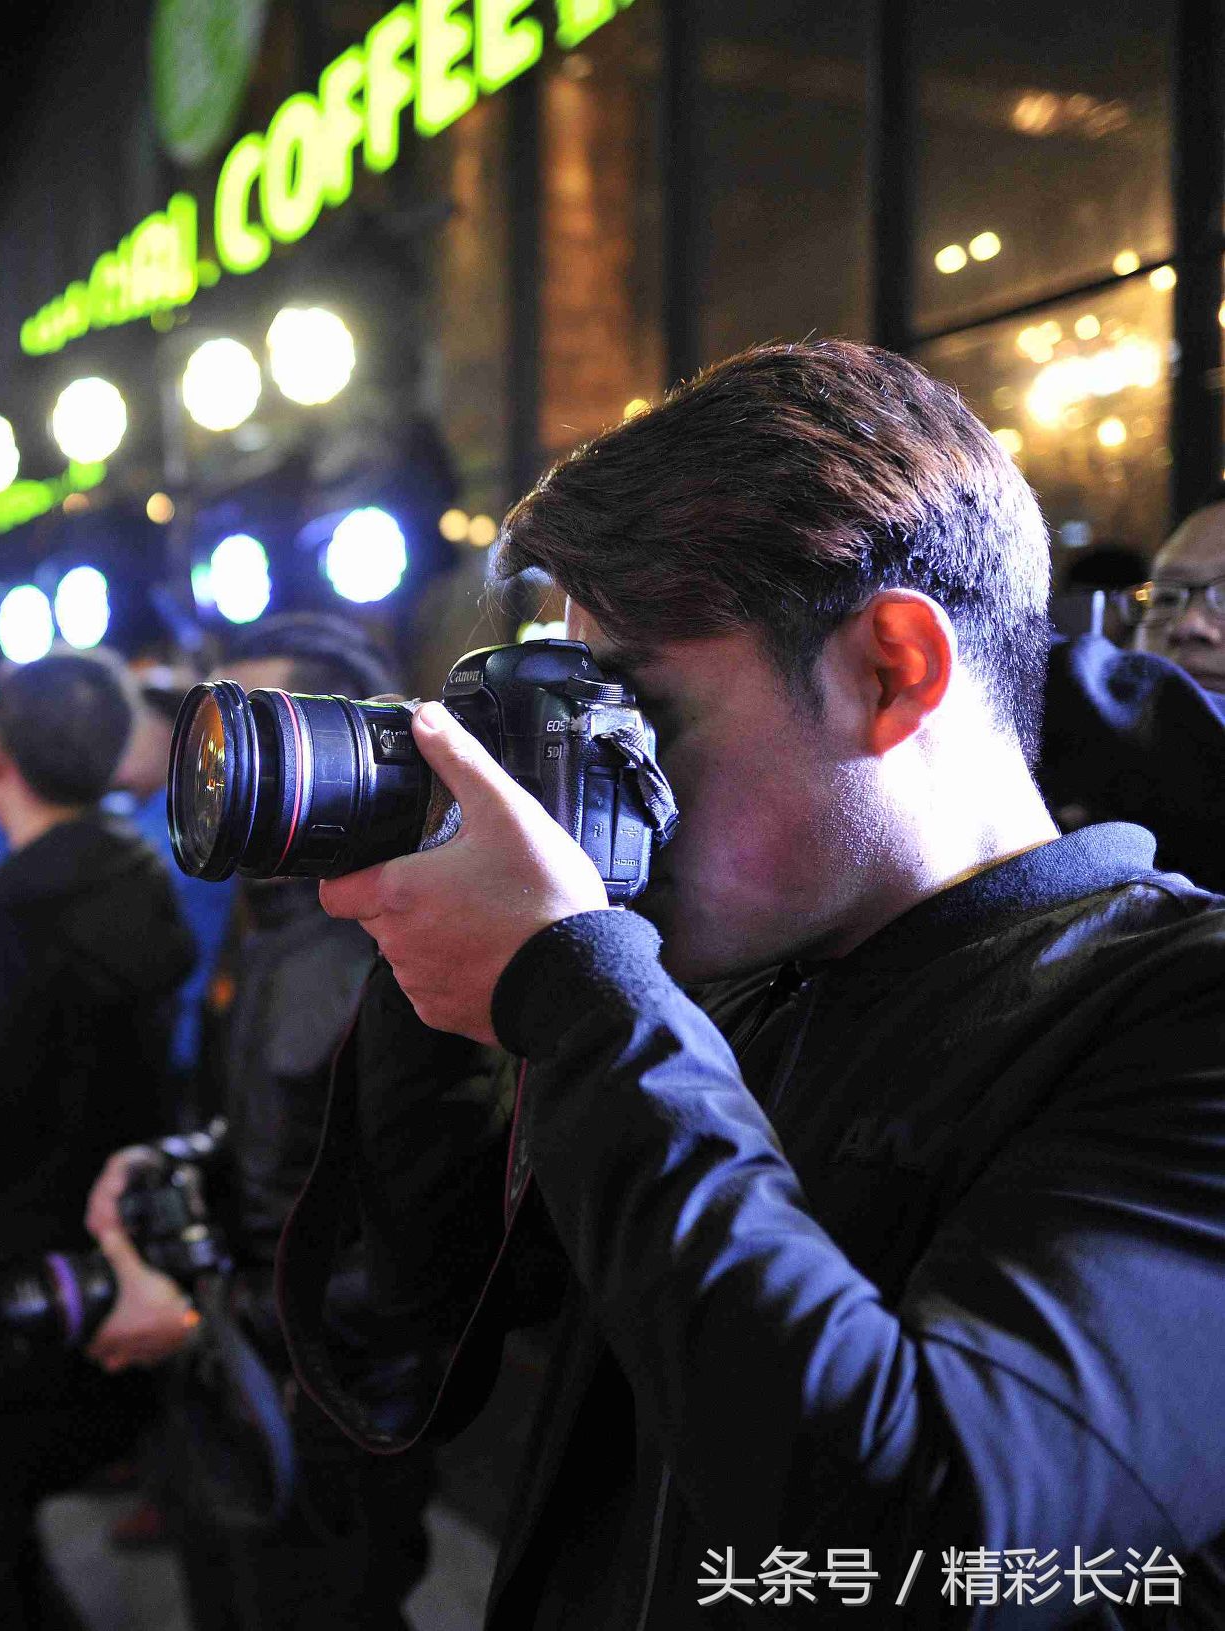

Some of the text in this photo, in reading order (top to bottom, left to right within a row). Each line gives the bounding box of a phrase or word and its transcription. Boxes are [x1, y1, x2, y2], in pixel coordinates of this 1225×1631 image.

[215, 0, 543, 275] COFFEE
[449, 669, 481, 684] Canon
[546, 720, 567, 732] EOS
